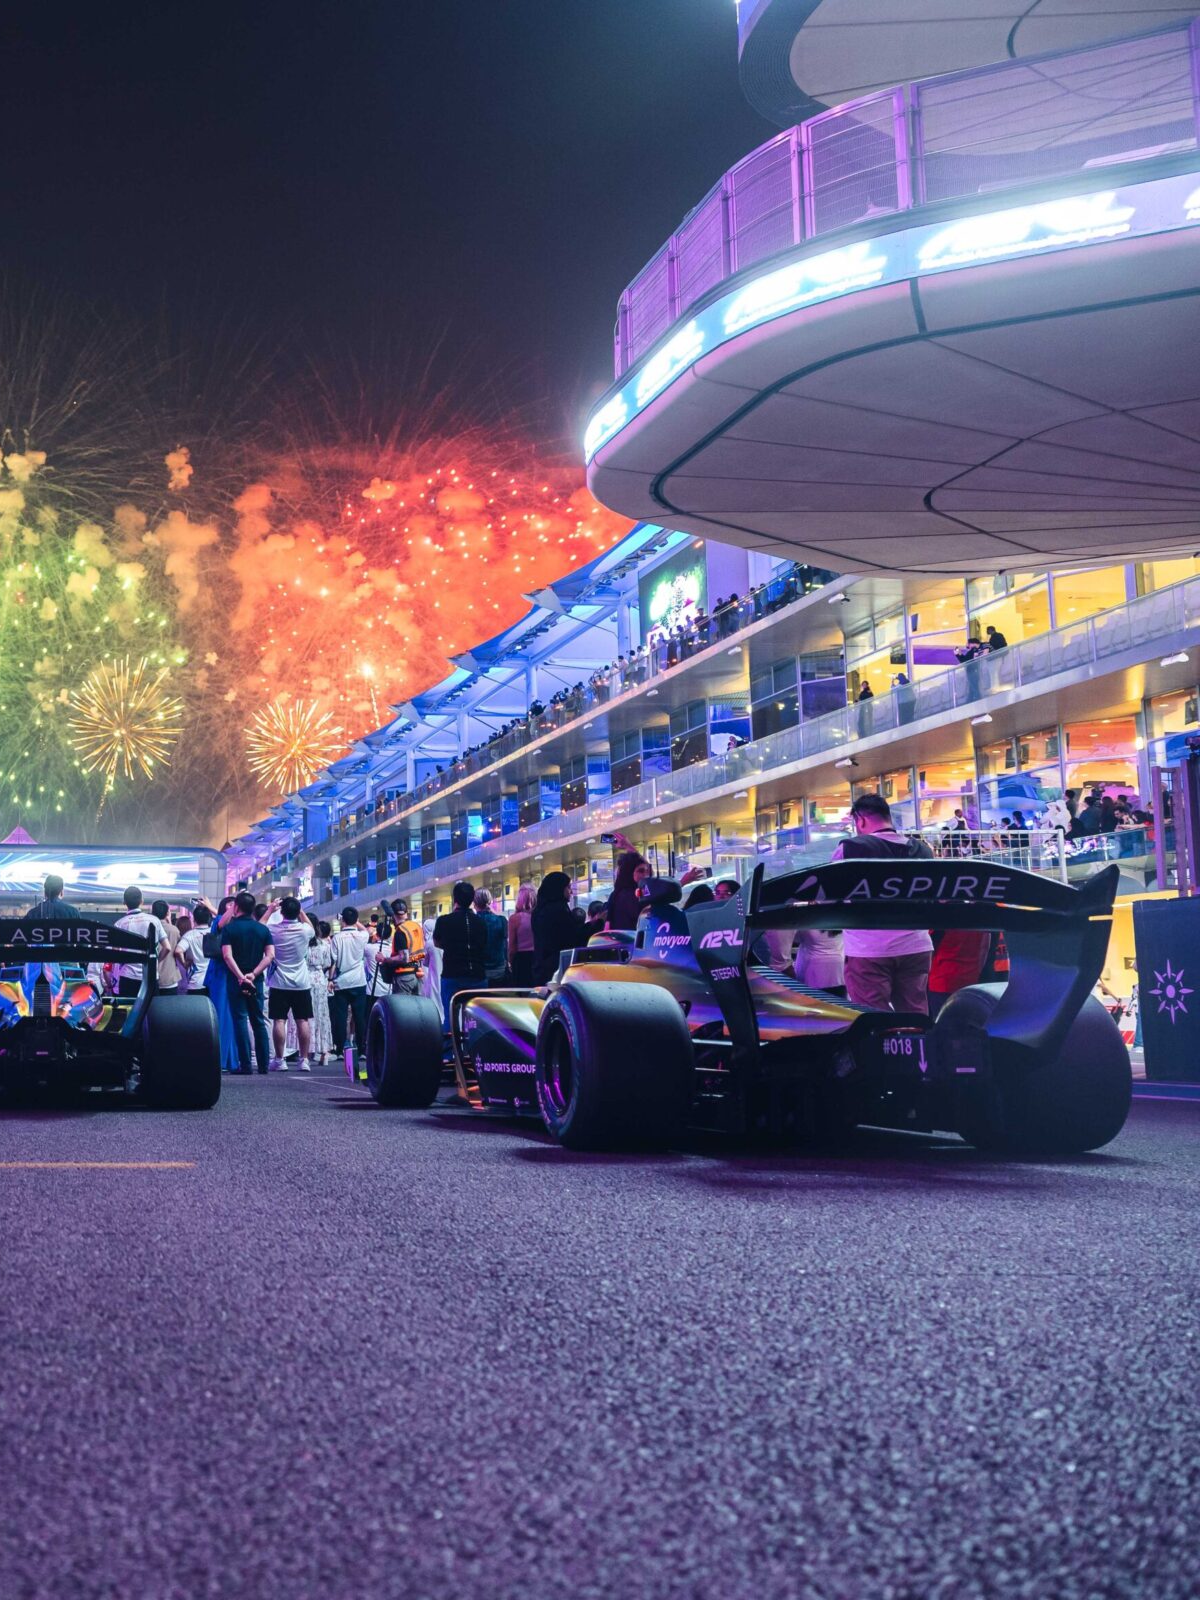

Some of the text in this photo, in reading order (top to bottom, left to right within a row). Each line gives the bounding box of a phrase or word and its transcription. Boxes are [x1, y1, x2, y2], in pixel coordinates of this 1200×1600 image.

[845, 876, 1011, 899] ASPIRE
[11, 927, 109, 944] ASPIRE
[653, 935, 692, 949] movyon
[700, 928, 743, 949] A2RL
[883, 1038, 913, 1055] #018
[483, 1063, 491, 1072] AD
[491, 1063, 510, 1073] PORTS
